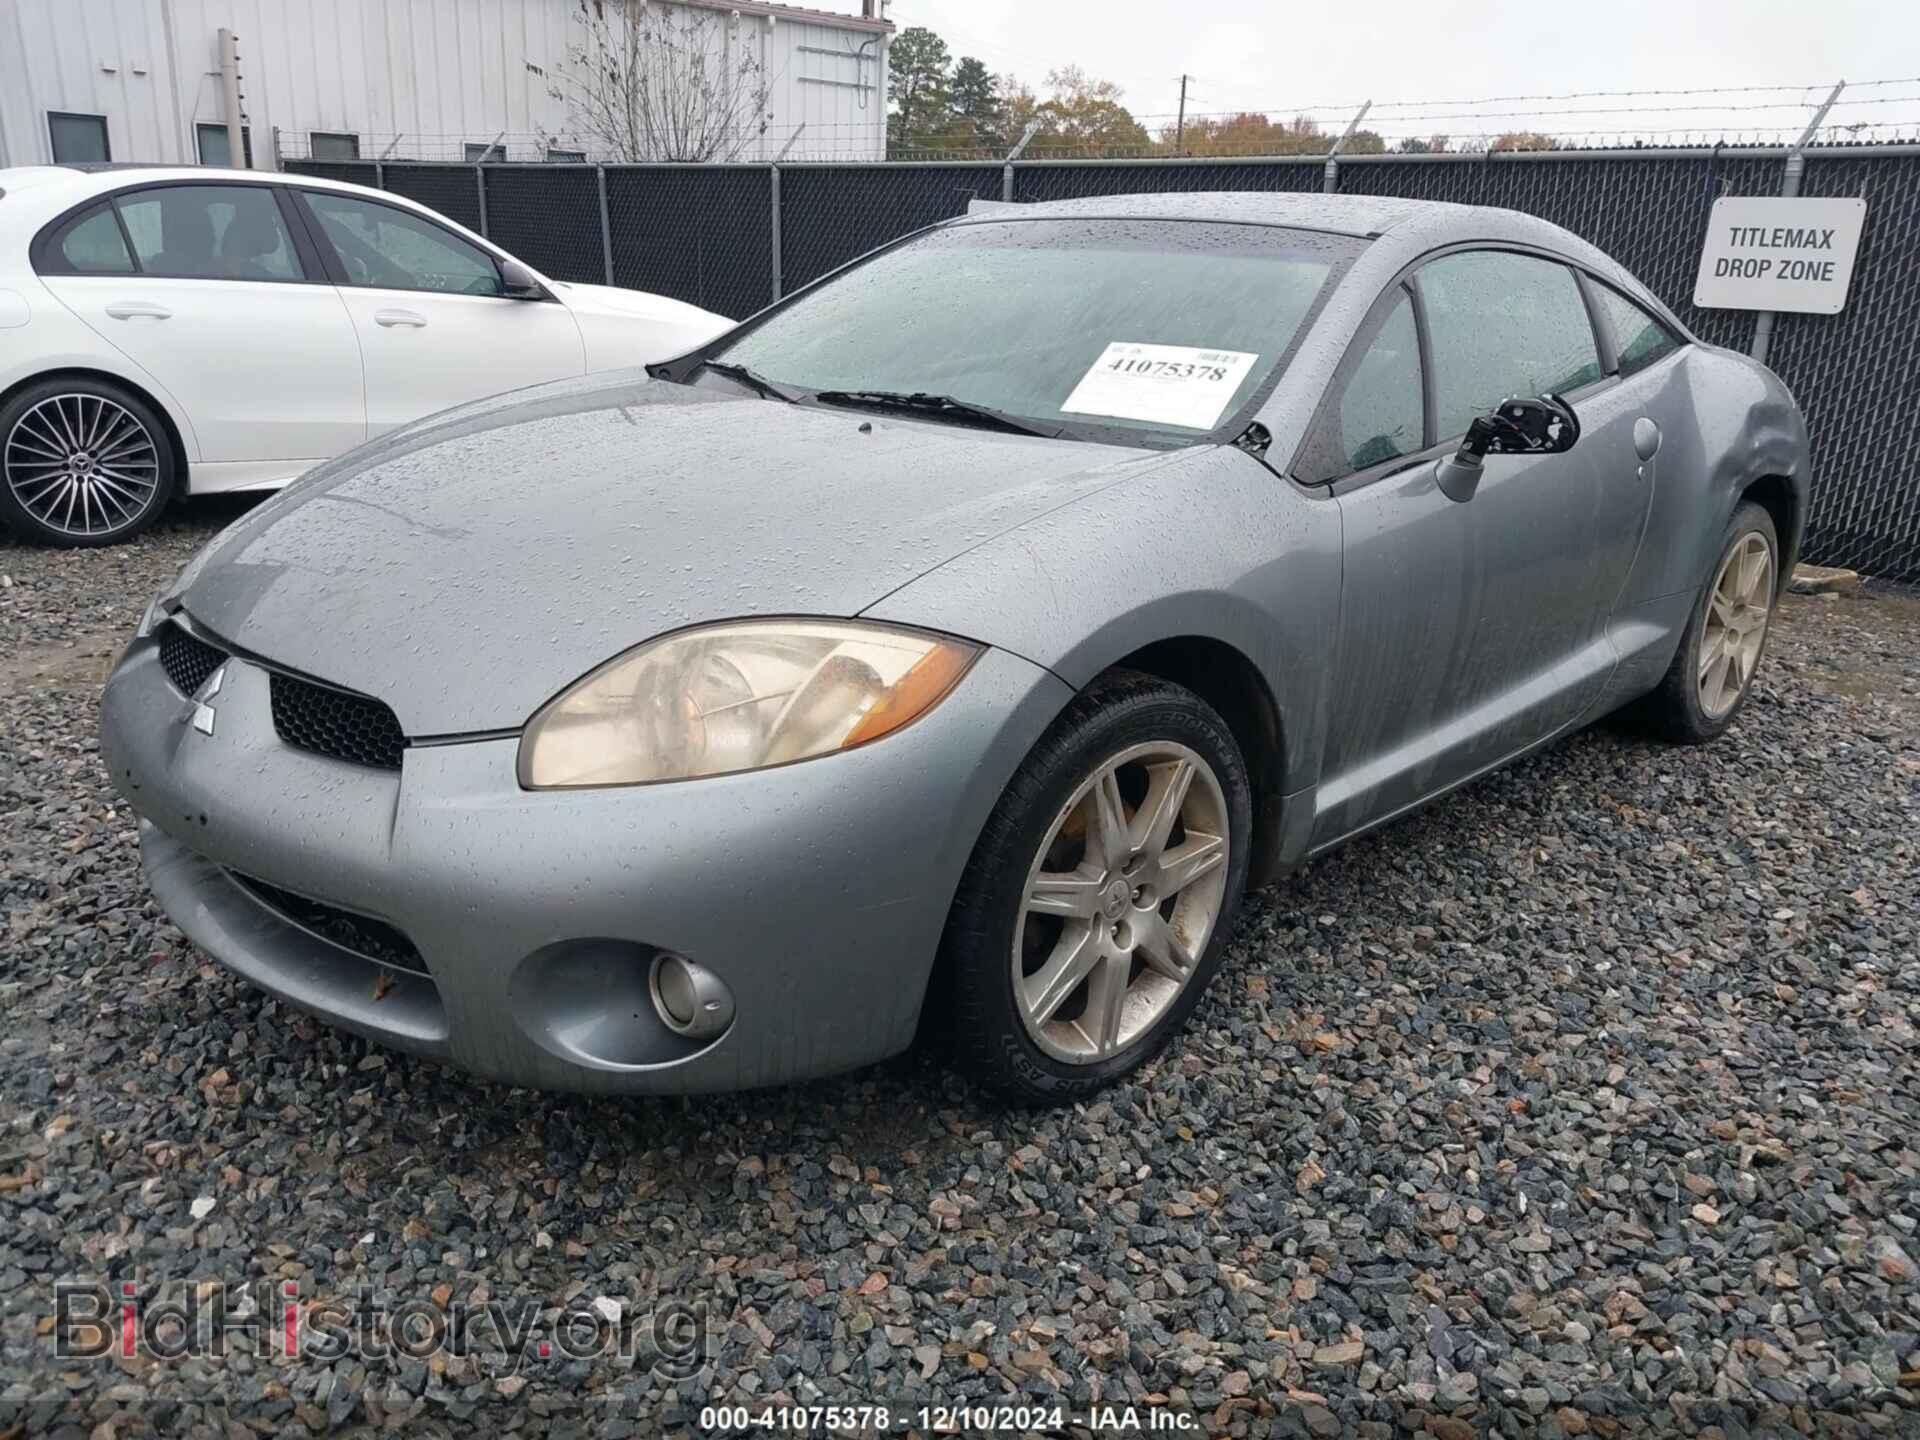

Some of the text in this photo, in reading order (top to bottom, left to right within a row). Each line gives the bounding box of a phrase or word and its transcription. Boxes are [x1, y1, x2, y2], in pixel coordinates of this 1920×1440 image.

[1729, 227, 1835, 249] TITLEMAX
[1714, 257, 1836, 282] DROP ZONE
[1108, 358, 1227, 381] 41075378
